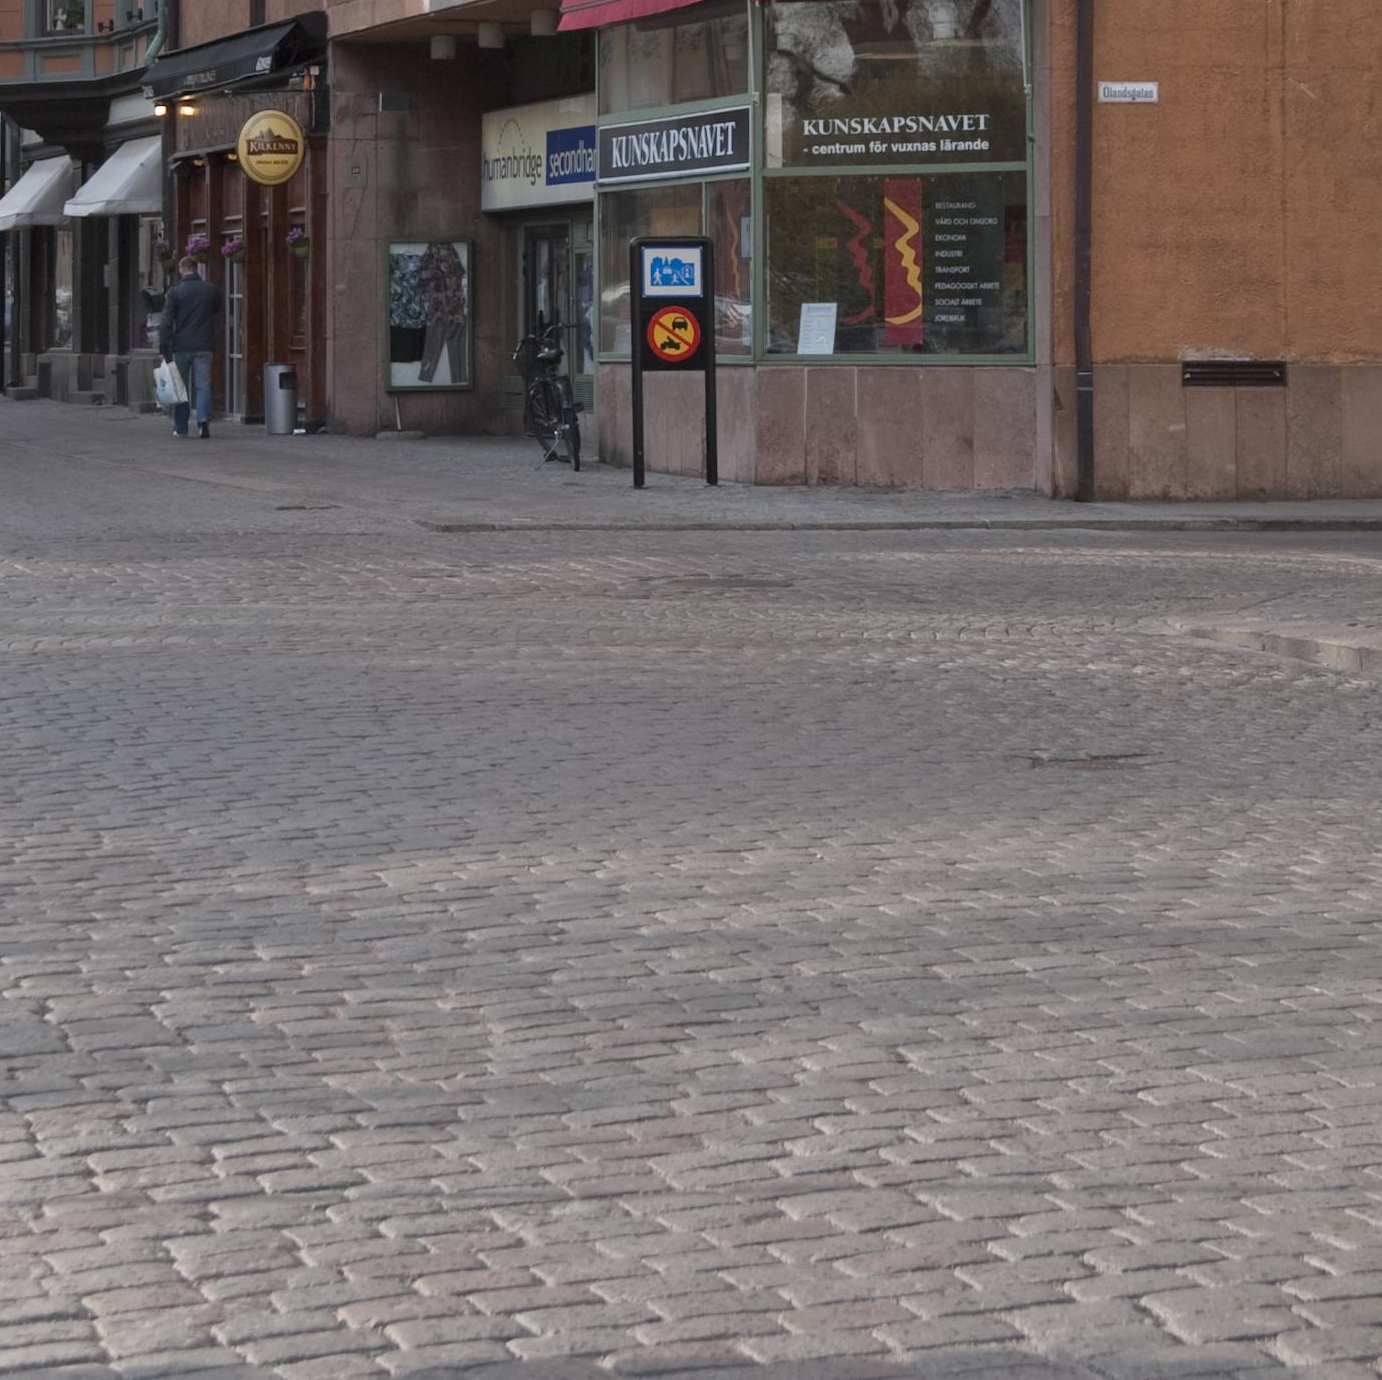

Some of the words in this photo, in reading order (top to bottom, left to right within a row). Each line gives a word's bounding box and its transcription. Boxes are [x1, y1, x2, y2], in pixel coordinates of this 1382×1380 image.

[803, 113, 990, 136] KUNSKAPSNAVET
[249, 140, 297, 153] KILKENNY
[611, 121, 736, 168] KUNSKAPSNAVET
[812, 142, 866, 155] centrum
[869, 140, 889, 154] för
[891, 141, 937, 153] vuxnas
[940, 138, 990, 151] lärande
[483, 145, 543, 186] humanbridge
